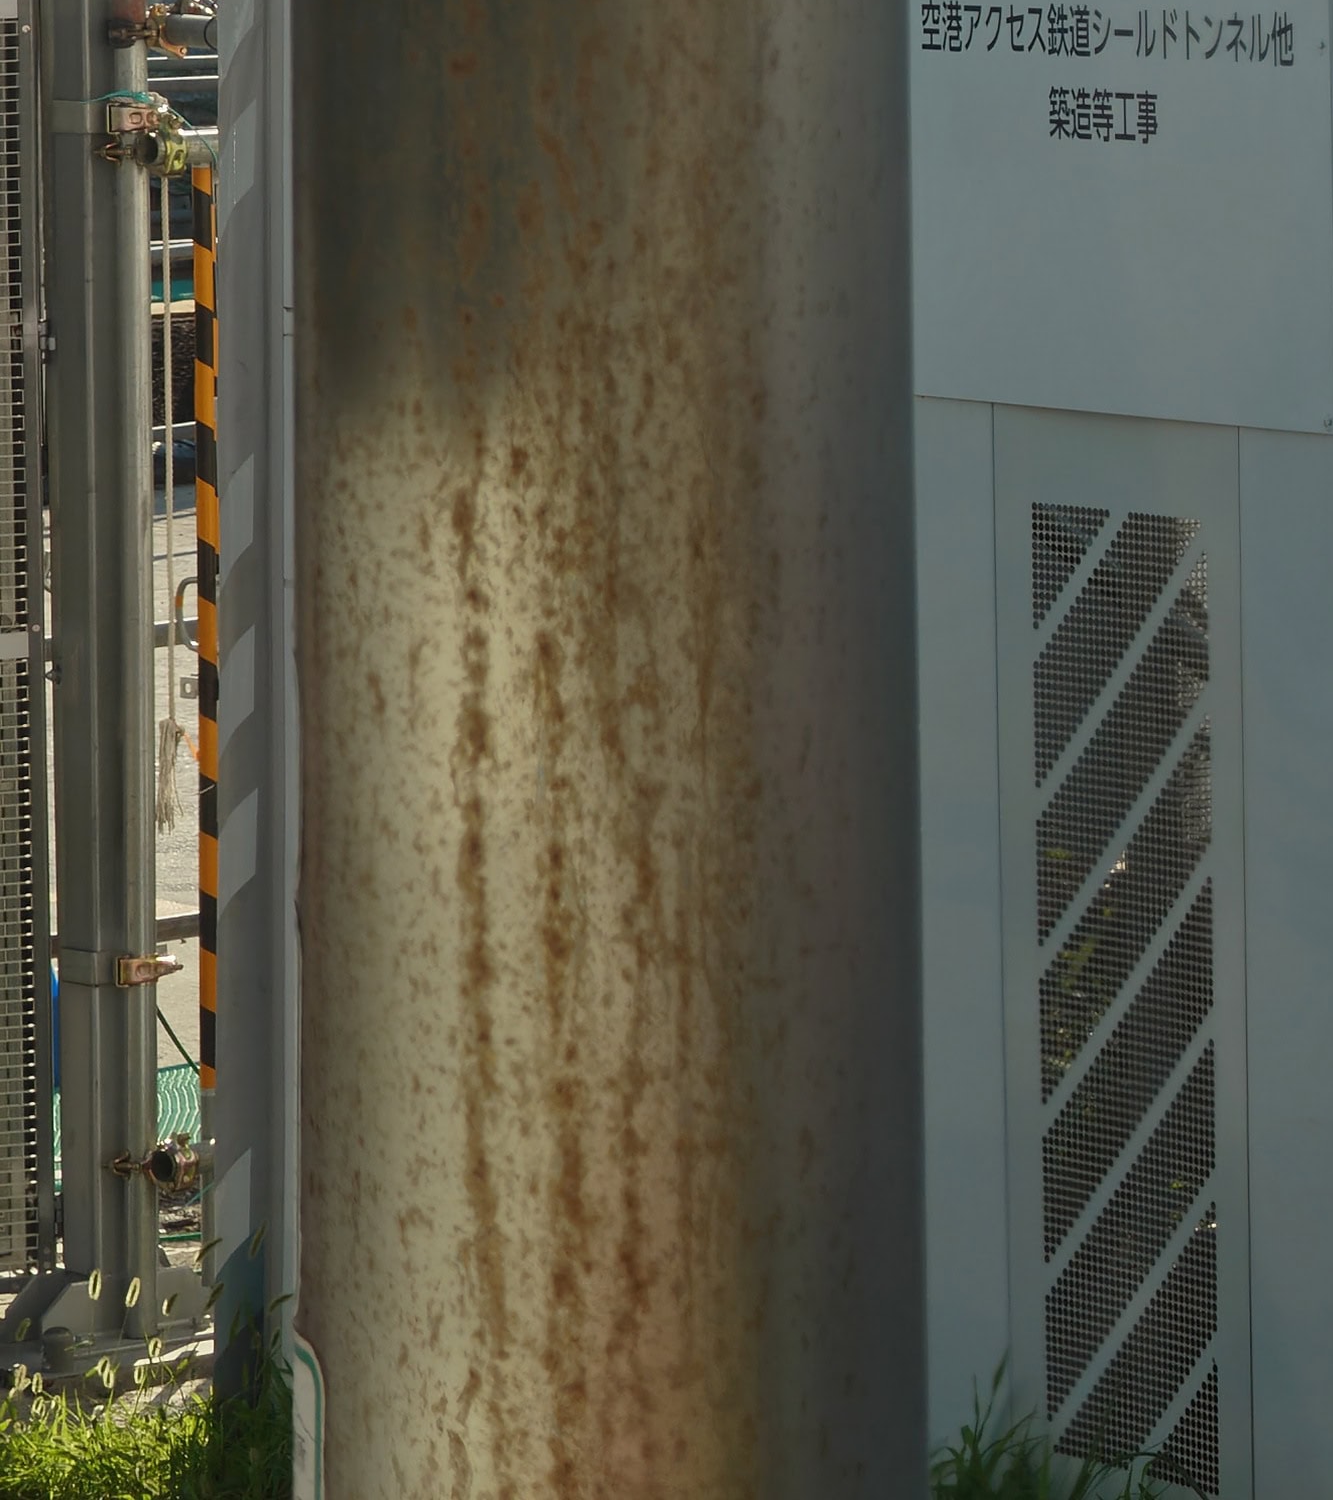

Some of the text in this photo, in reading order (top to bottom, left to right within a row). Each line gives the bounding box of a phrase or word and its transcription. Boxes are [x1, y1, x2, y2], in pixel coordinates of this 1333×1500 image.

[921, 0, 1294, 67] 空港アクセス鉄道シールドトンネル他
[1049, 86, 1158, 144] 築造等工事
